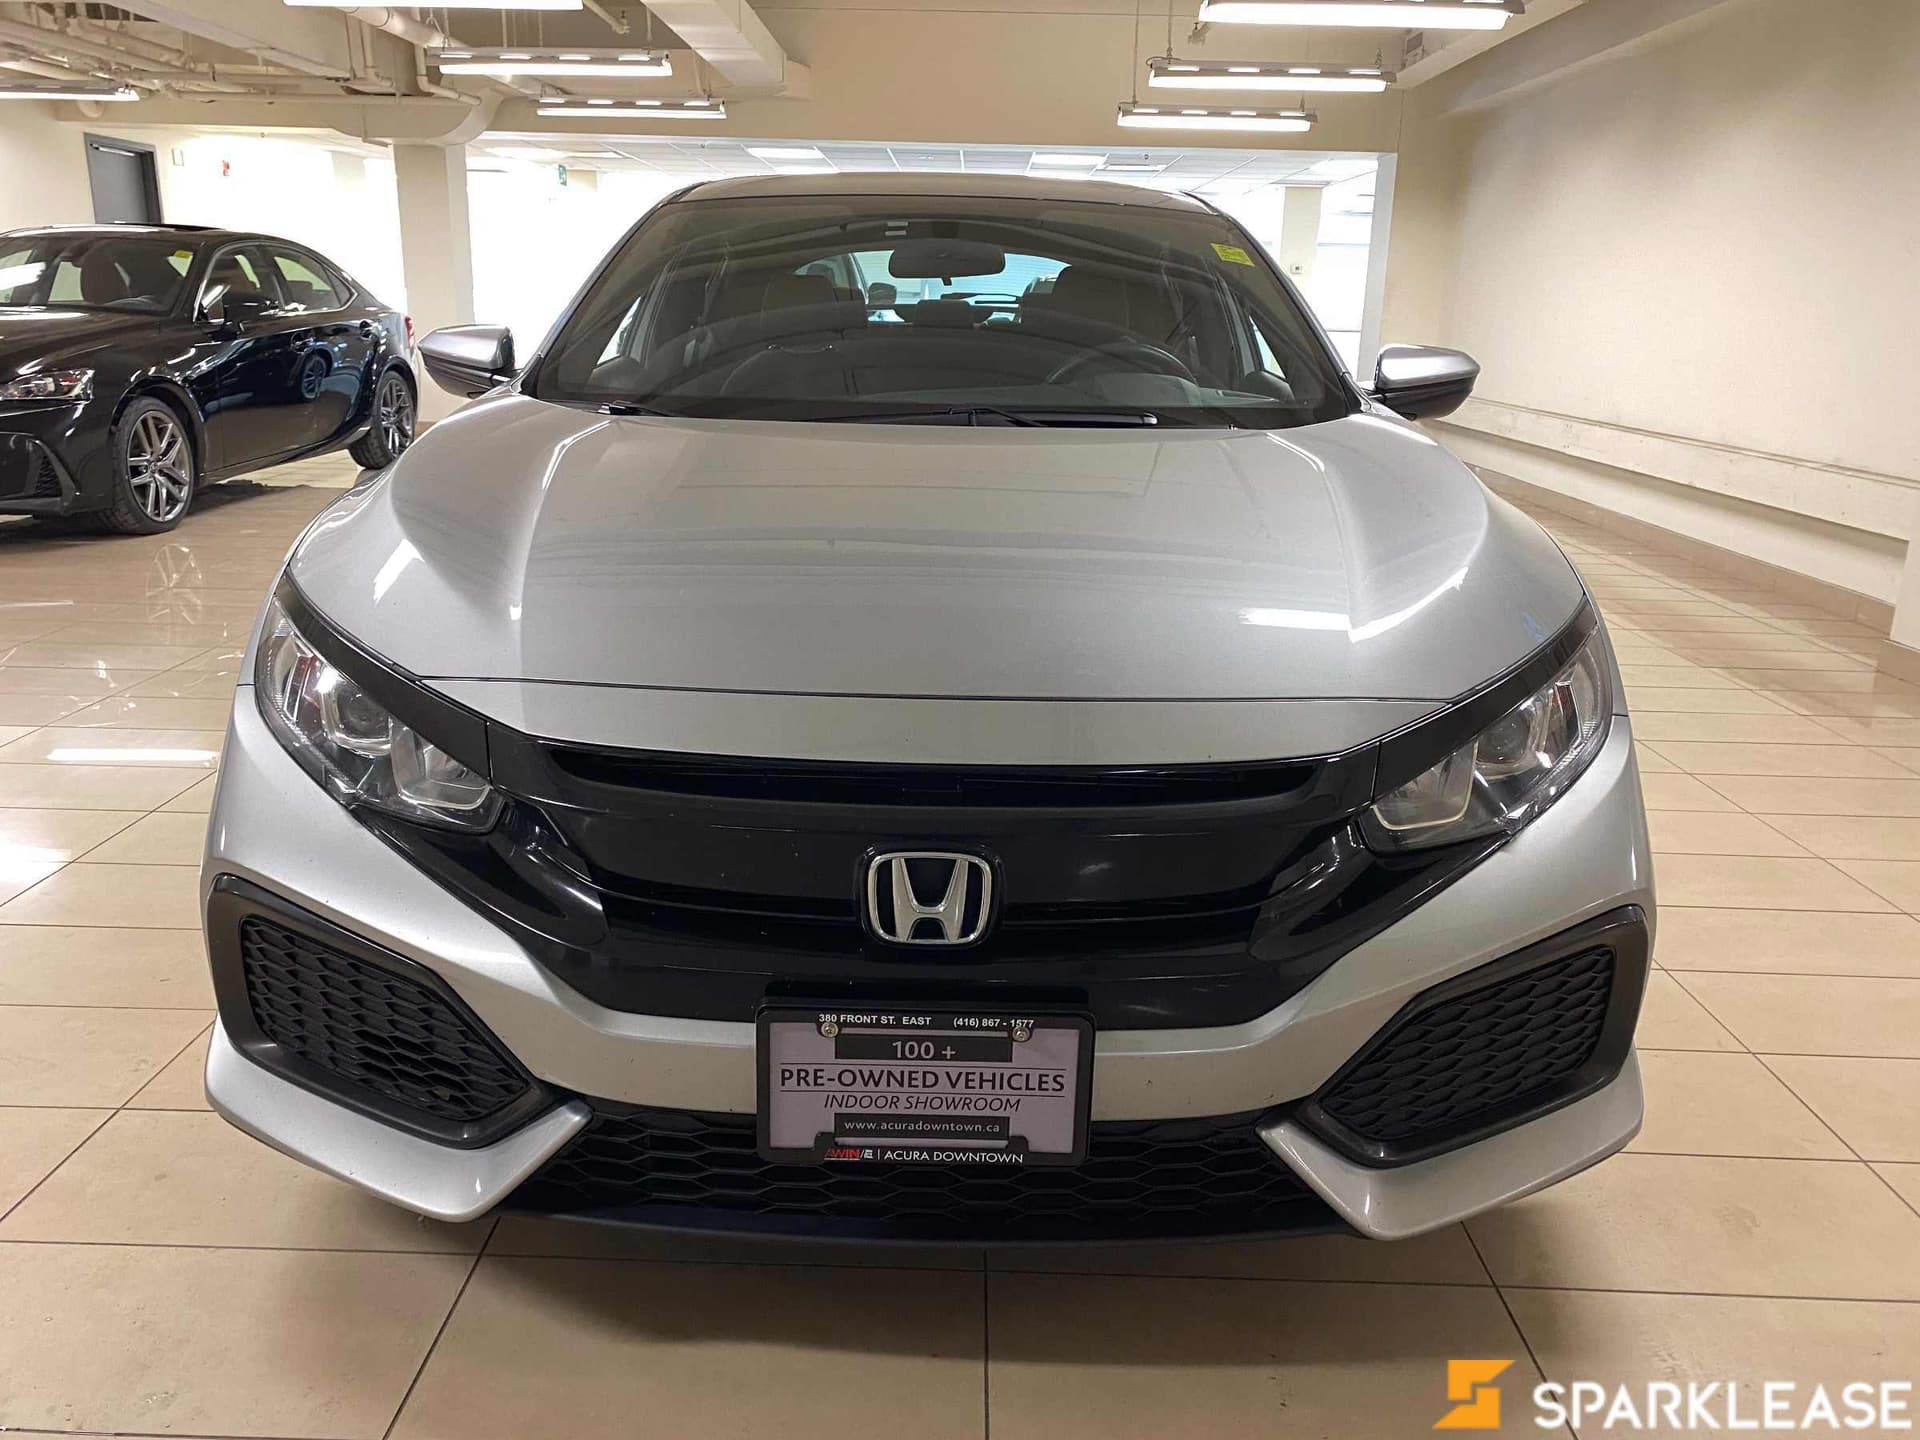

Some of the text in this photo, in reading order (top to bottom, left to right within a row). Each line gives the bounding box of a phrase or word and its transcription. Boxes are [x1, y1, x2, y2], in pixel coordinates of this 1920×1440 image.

[819, 1014, 932, 1025] 380 FRONT ST. EAST
[953, 1017, 979, 1028] (416)
[981, 1018, 1001, 1027] 867
[1010, 1019, 1034, 1029] 1577
[892, 1041, 935, 1059] 100
[780, 1068, 1065, 1092] PRE-OWNED VEHICLES
[824, 1094, 1021, 1112] INDOOR SHOWROOM
[844, 1120, 1000, 1133] www.acuradowntown.ca
[884, 1150, 930, 1161] ACURA
[933, 1151, 1023, 1163] DOWNTOWN
